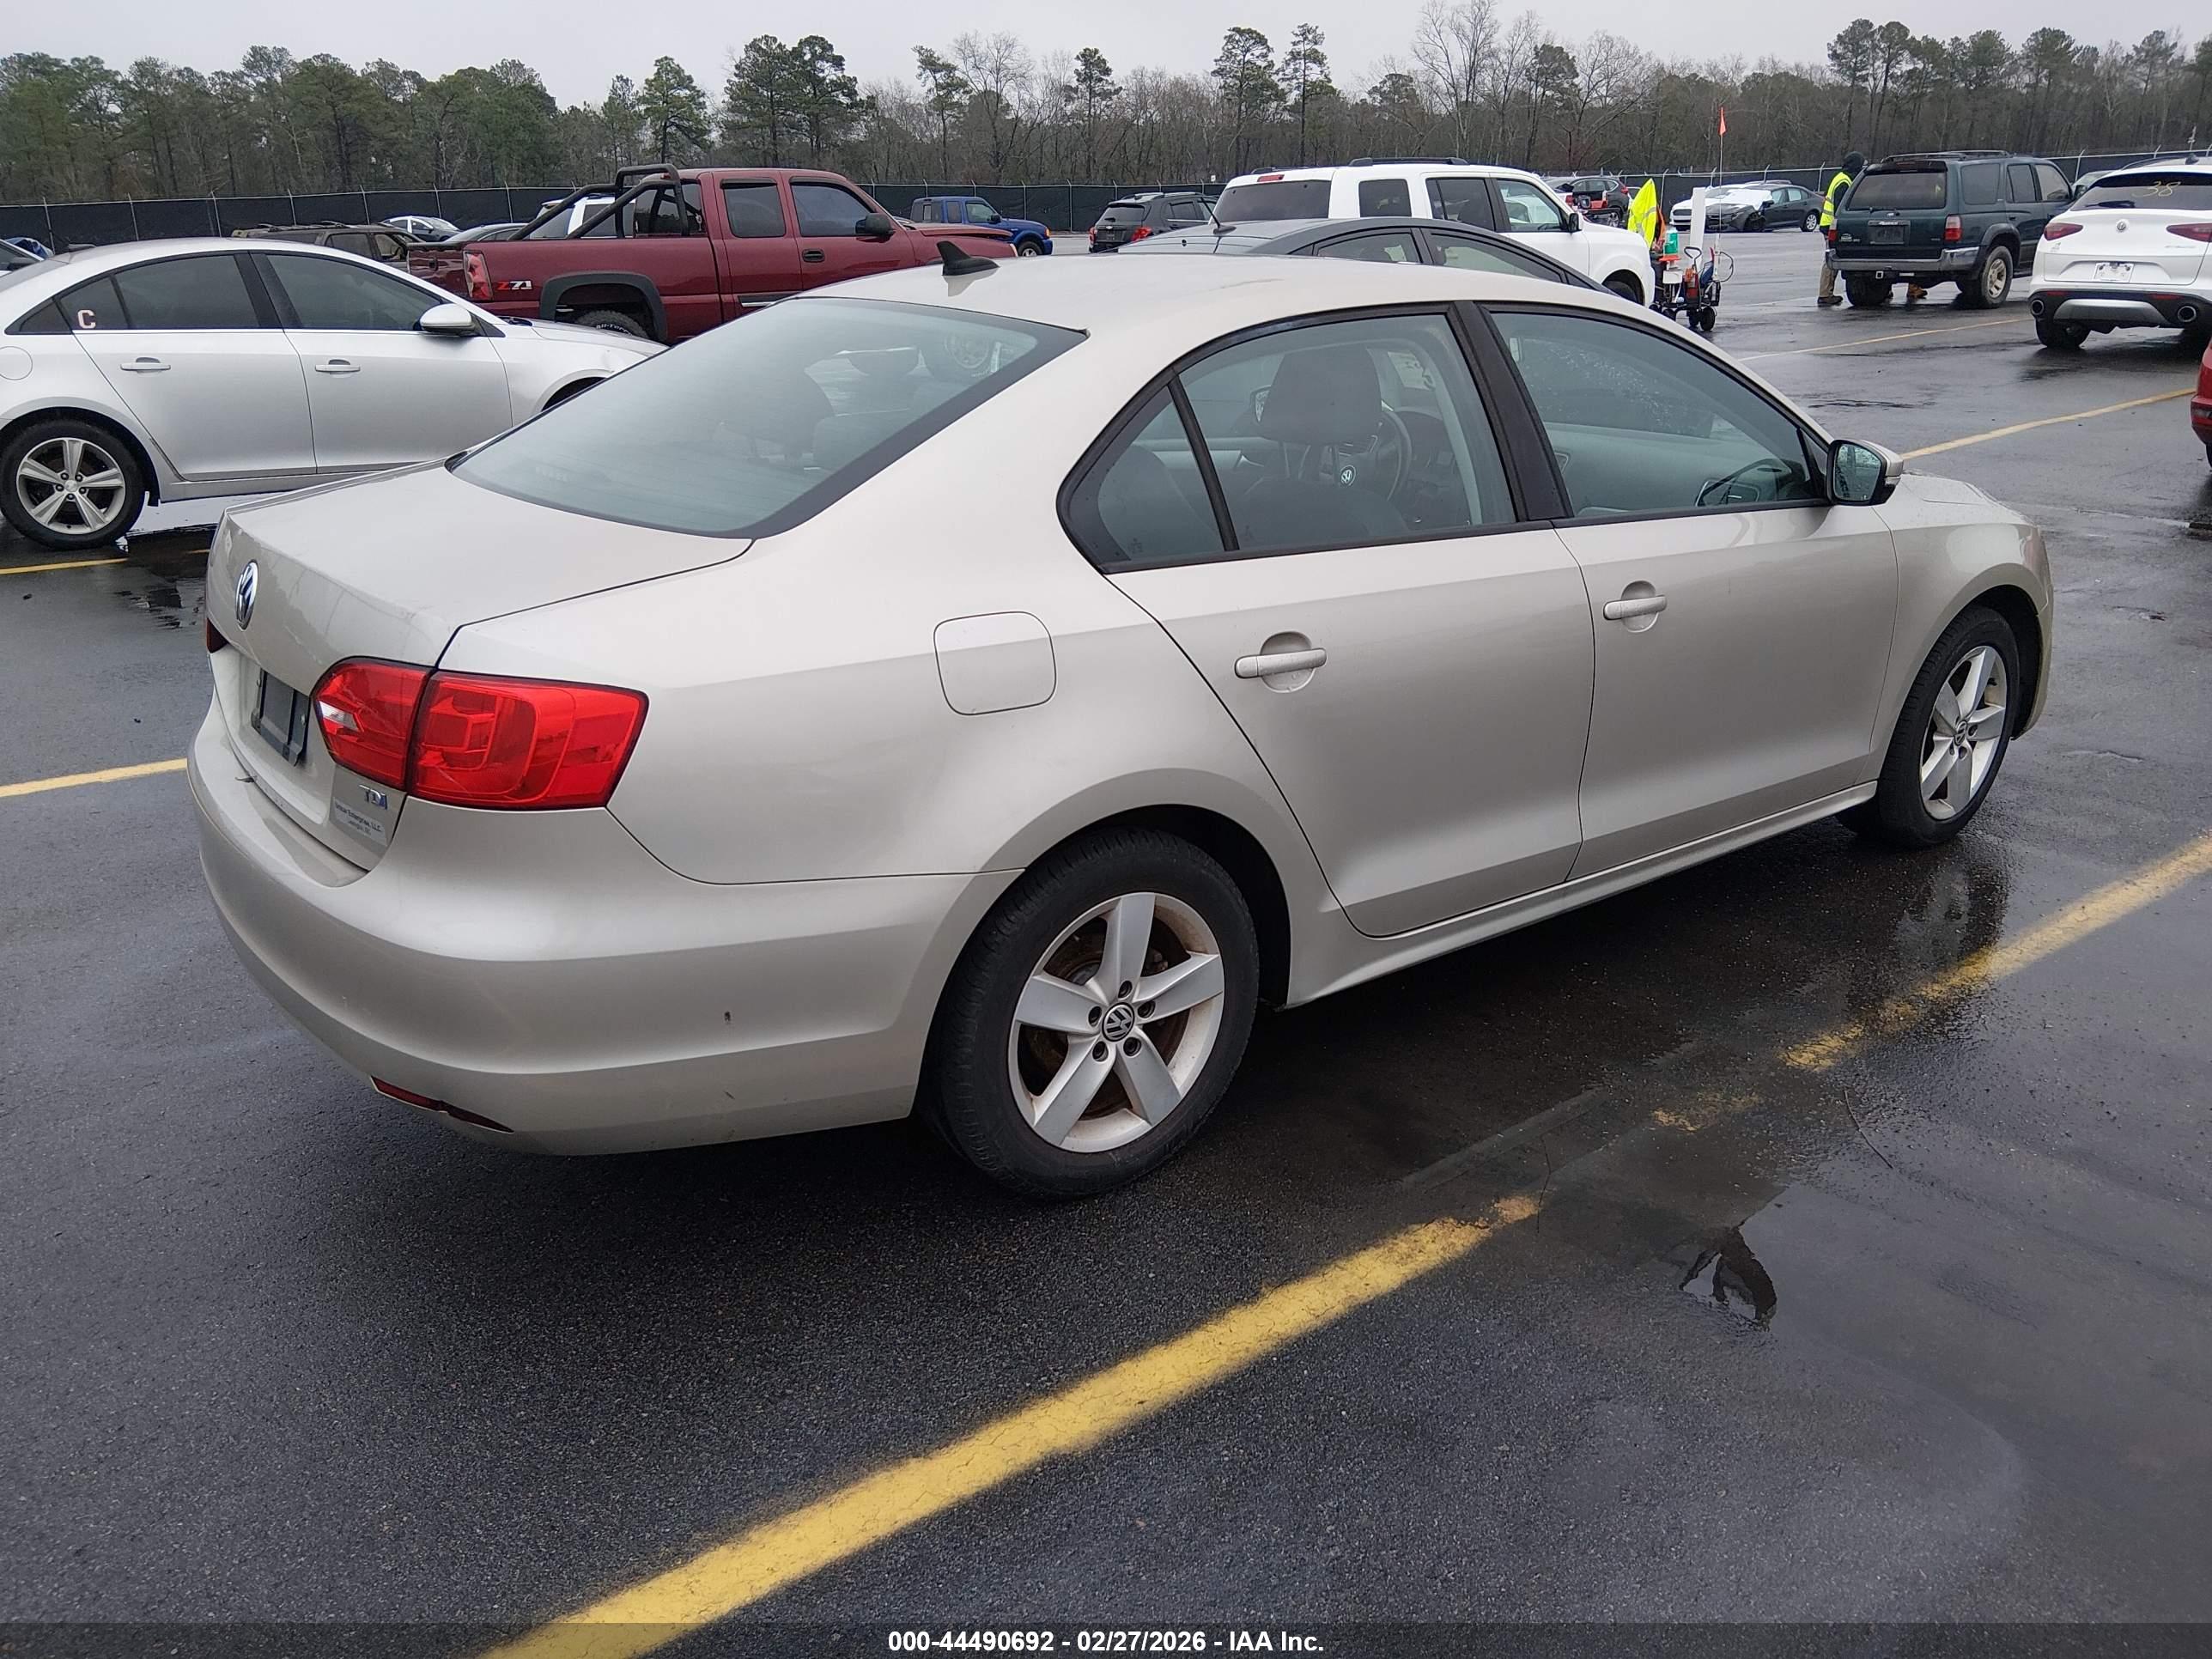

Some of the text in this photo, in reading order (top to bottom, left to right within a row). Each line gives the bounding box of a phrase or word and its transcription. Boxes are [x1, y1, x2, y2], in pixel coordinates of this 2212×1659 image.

[2131, 180, 2182, 198] 38
[496, 281, 532, 290] Z71
[77, 309, 96, 329] C
[358, 784, 388, 810] TDI
